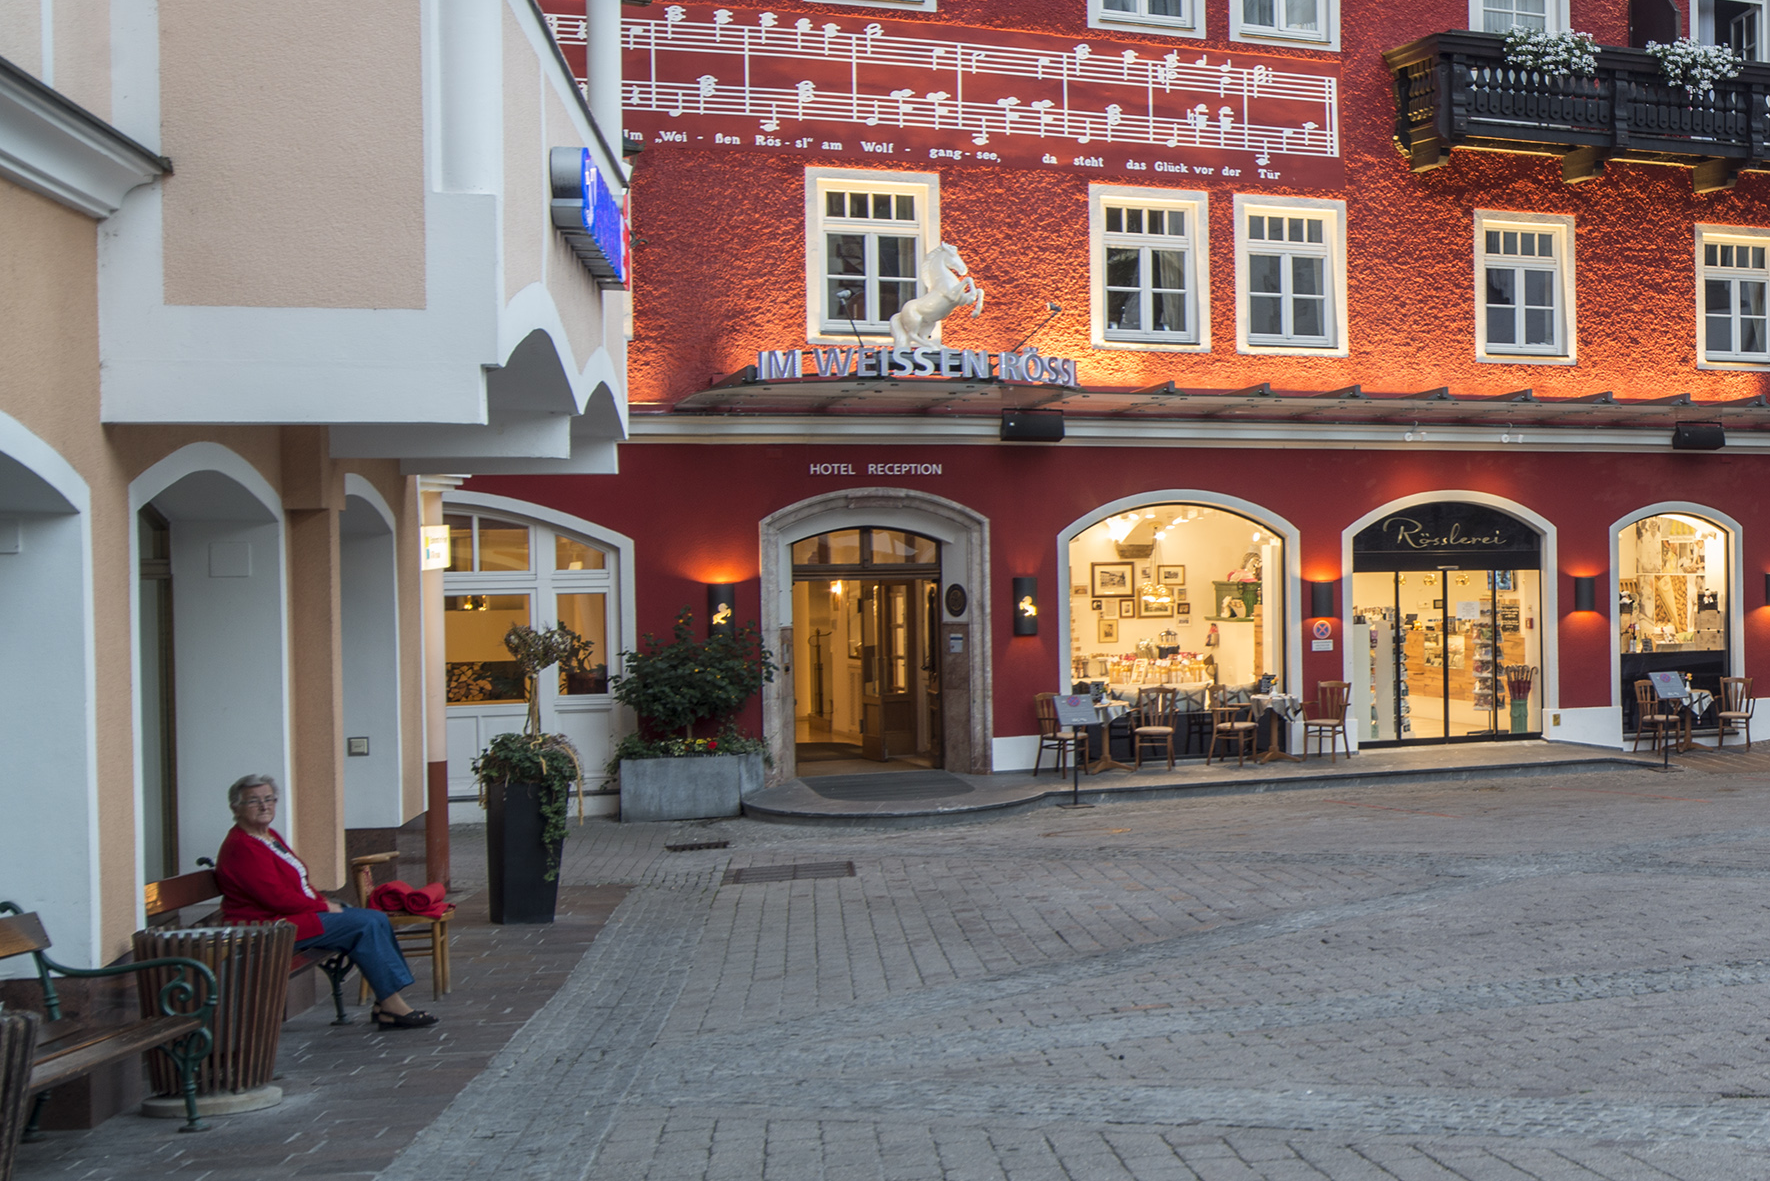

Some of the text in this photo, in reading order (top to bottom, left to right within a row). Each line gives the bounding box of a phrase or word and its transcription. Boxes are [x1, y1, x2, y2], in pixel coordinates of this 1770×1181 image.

[715, 132, 741, 145] ßen
[821, 141, 843, 151] am
[860, 141, 894, 154] Wolf
[1042, 153, 1058, 164] da
[1073, 156, 1104, 168] steht
[1126, 159, 1147, 170] das
[1154, 160, 1189, 174] Glück
[1193, 166, 1214, 175] vor
[1221, 166, 1242, 177] der
[1257, 169, 1281, 180] Tür
[757, 346, 1080, 387] IM WEISSEN RÖSSL
[809, 463, 942, 475] HOTEL RECEPTION
[1383, 517, 1507, 548] Rösslerei
